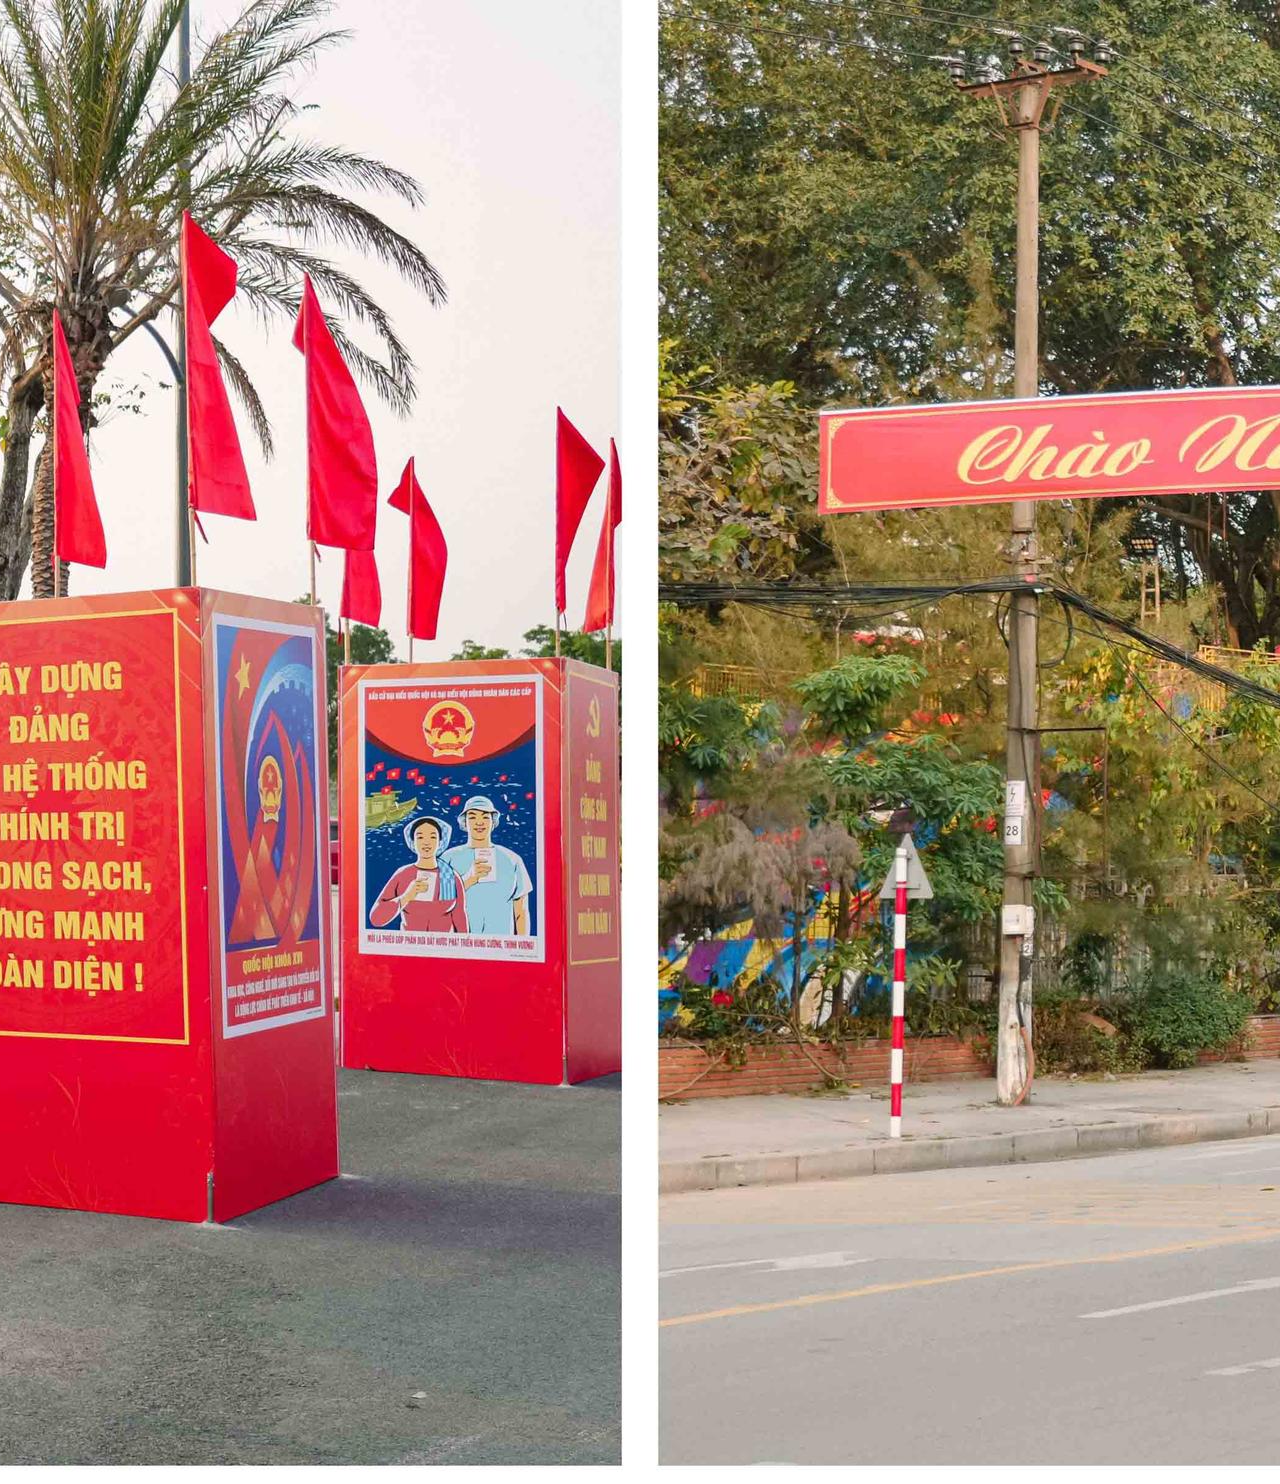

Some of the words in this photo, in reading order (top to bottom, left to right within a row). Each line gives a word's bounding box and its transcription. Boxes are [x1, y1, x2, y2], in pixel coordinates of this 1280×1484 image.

[957, 423, 1153, 485] Chào
[41, 660, 122, 698] DỰNG
[9, 705, 89, 744] ĐẢNG
[3, 758, 38, 798] HỆ
[48, 751, 147, 792] THỐNG
[78, 812, 125, 847] TRỊ
[1006, 826, 1018, 836] 28
[62, 861, 152, 896] SẠCH,
[54, 911, 144, 946] MẠNH
[53, 955, 123, 997] DIỆN
[135, 963, 143, 992] !
